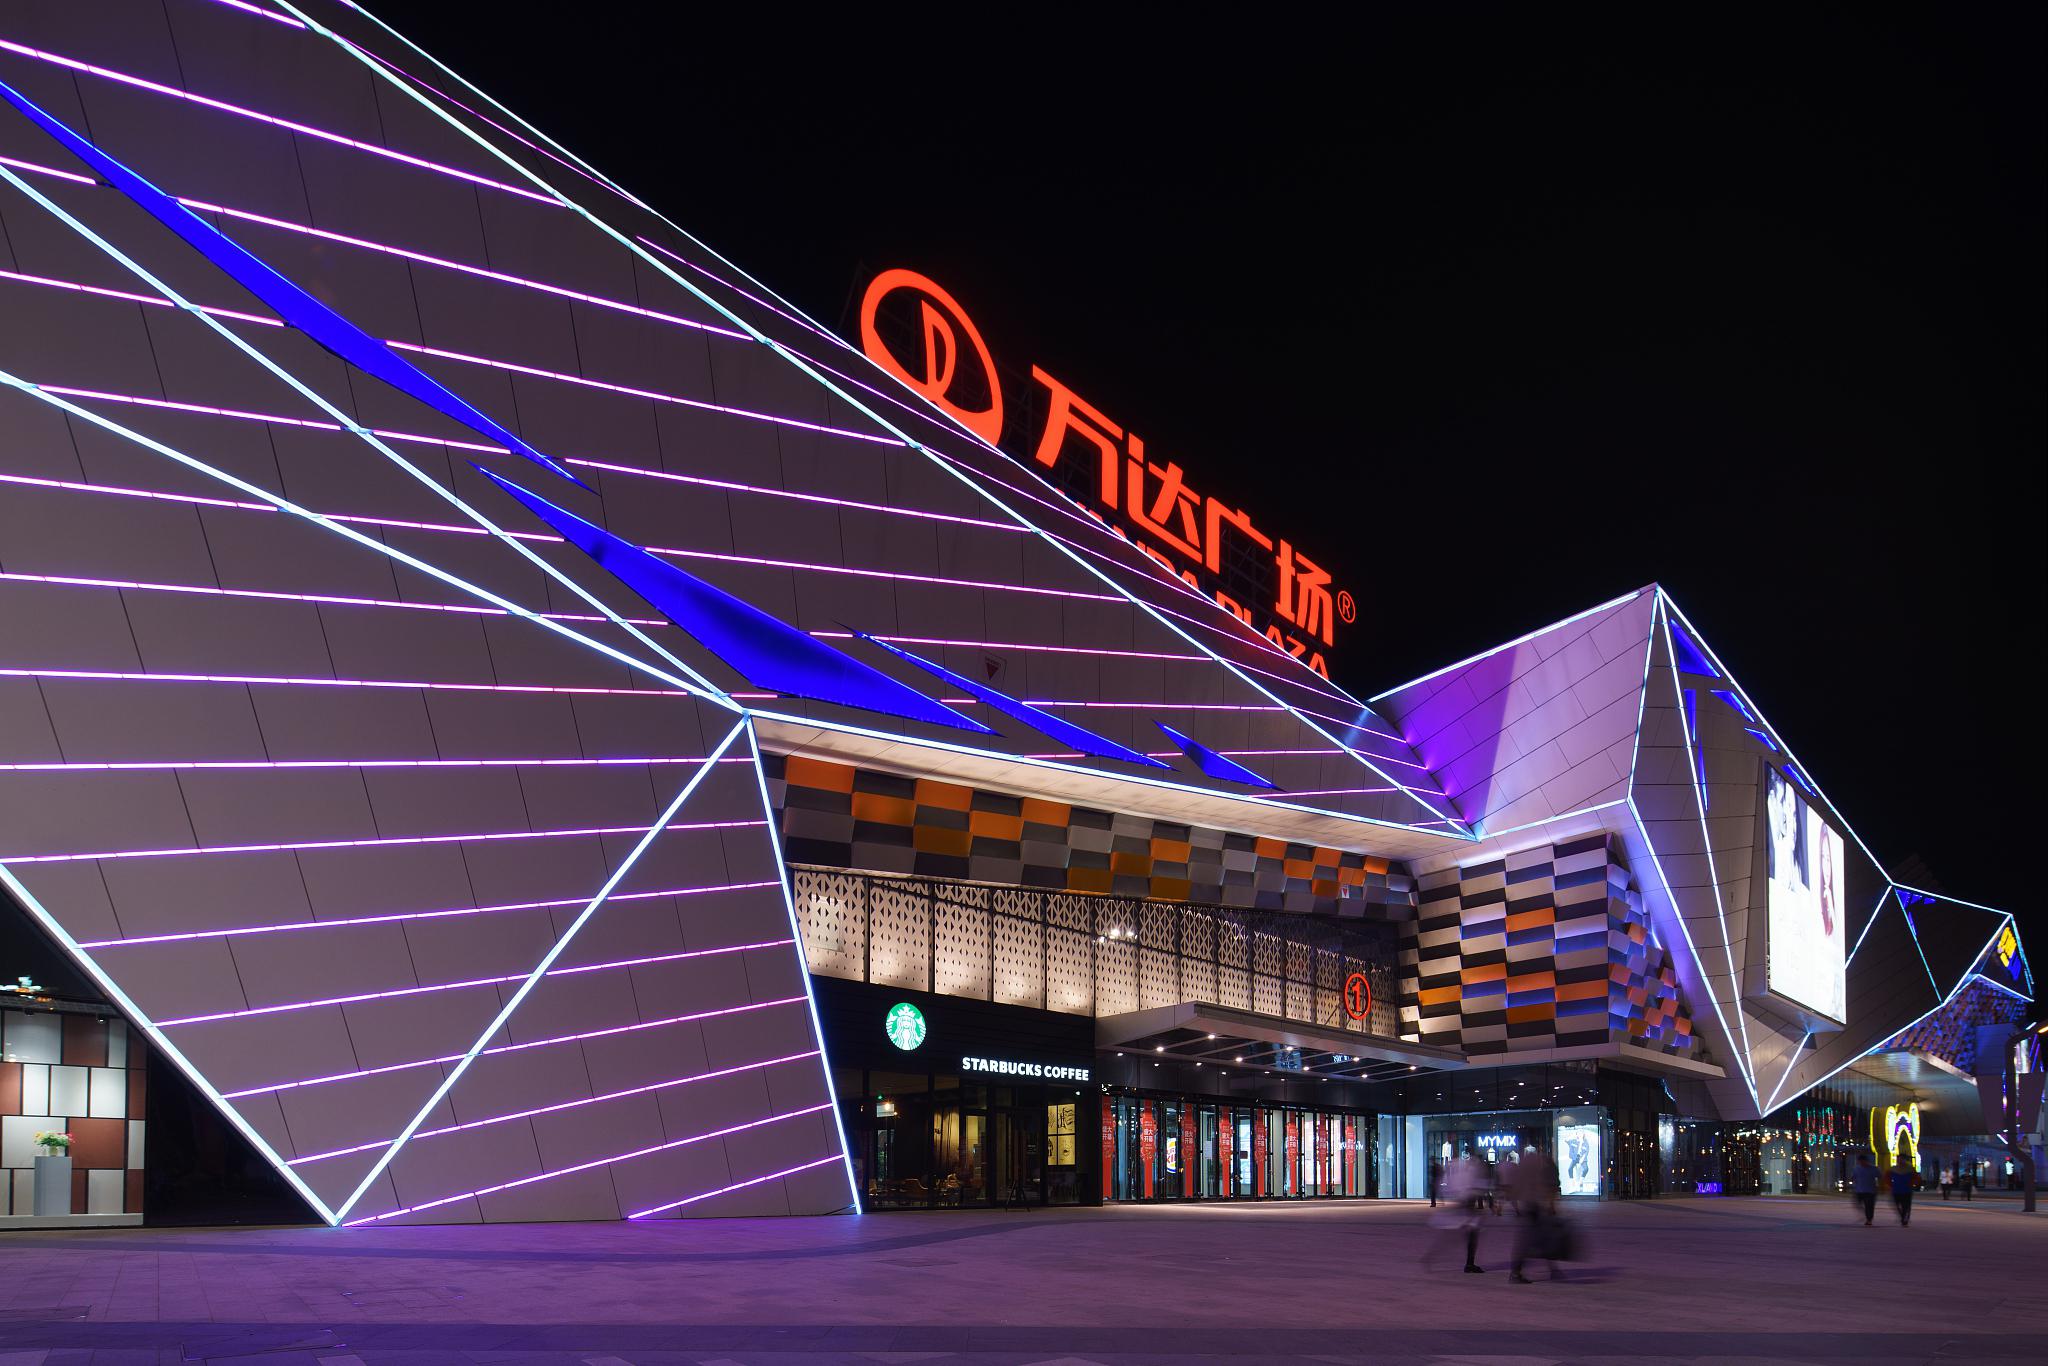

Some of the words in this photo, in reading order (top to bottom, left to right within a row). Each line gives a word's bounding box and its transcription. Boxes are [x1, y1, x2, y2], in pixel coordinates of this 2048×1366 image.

[1033, 364, 1333, 647] 万达广场
[962, 1057, 1042, 1077] STARBUCKS
[1044, 1065, 1089, 1081] COFFEE
[1478, 1135, 1516, 1147] MYMIX
